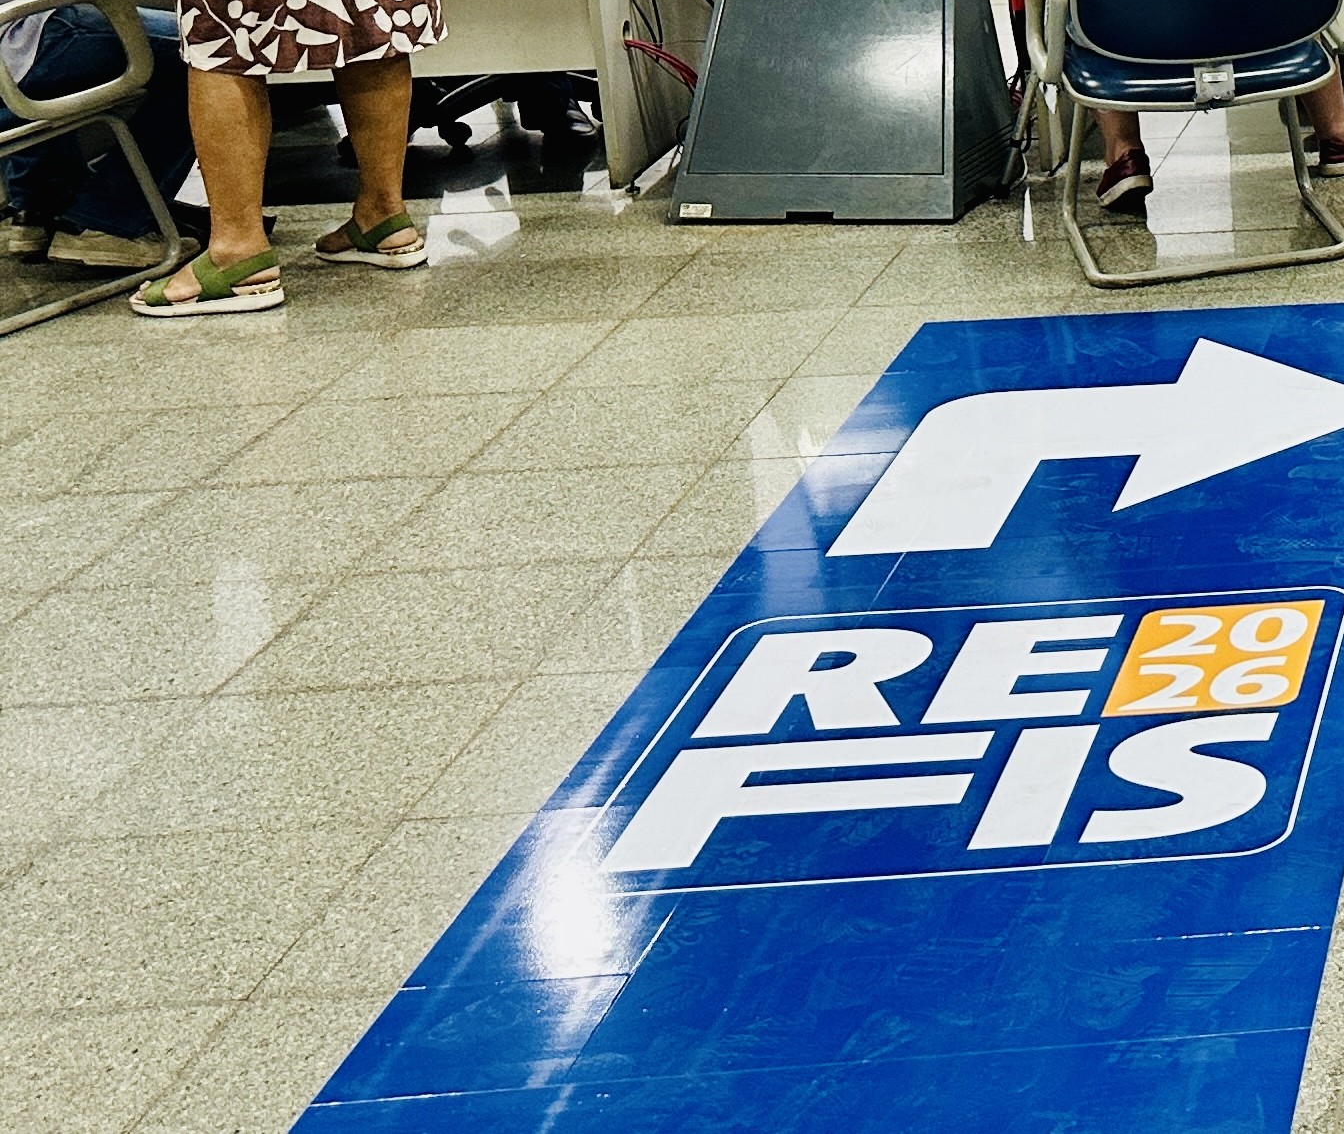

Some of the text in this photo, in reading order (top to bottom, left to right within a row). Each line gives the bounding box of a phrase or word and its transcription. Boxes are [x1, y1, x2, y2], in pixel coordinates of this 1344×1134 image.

[691, 614, 1124, 738] RE
[1156, 608, 1305, 656] 20
[1137, 656, 1290, 710] 26
[604, 712, 1279, 871] FIS
